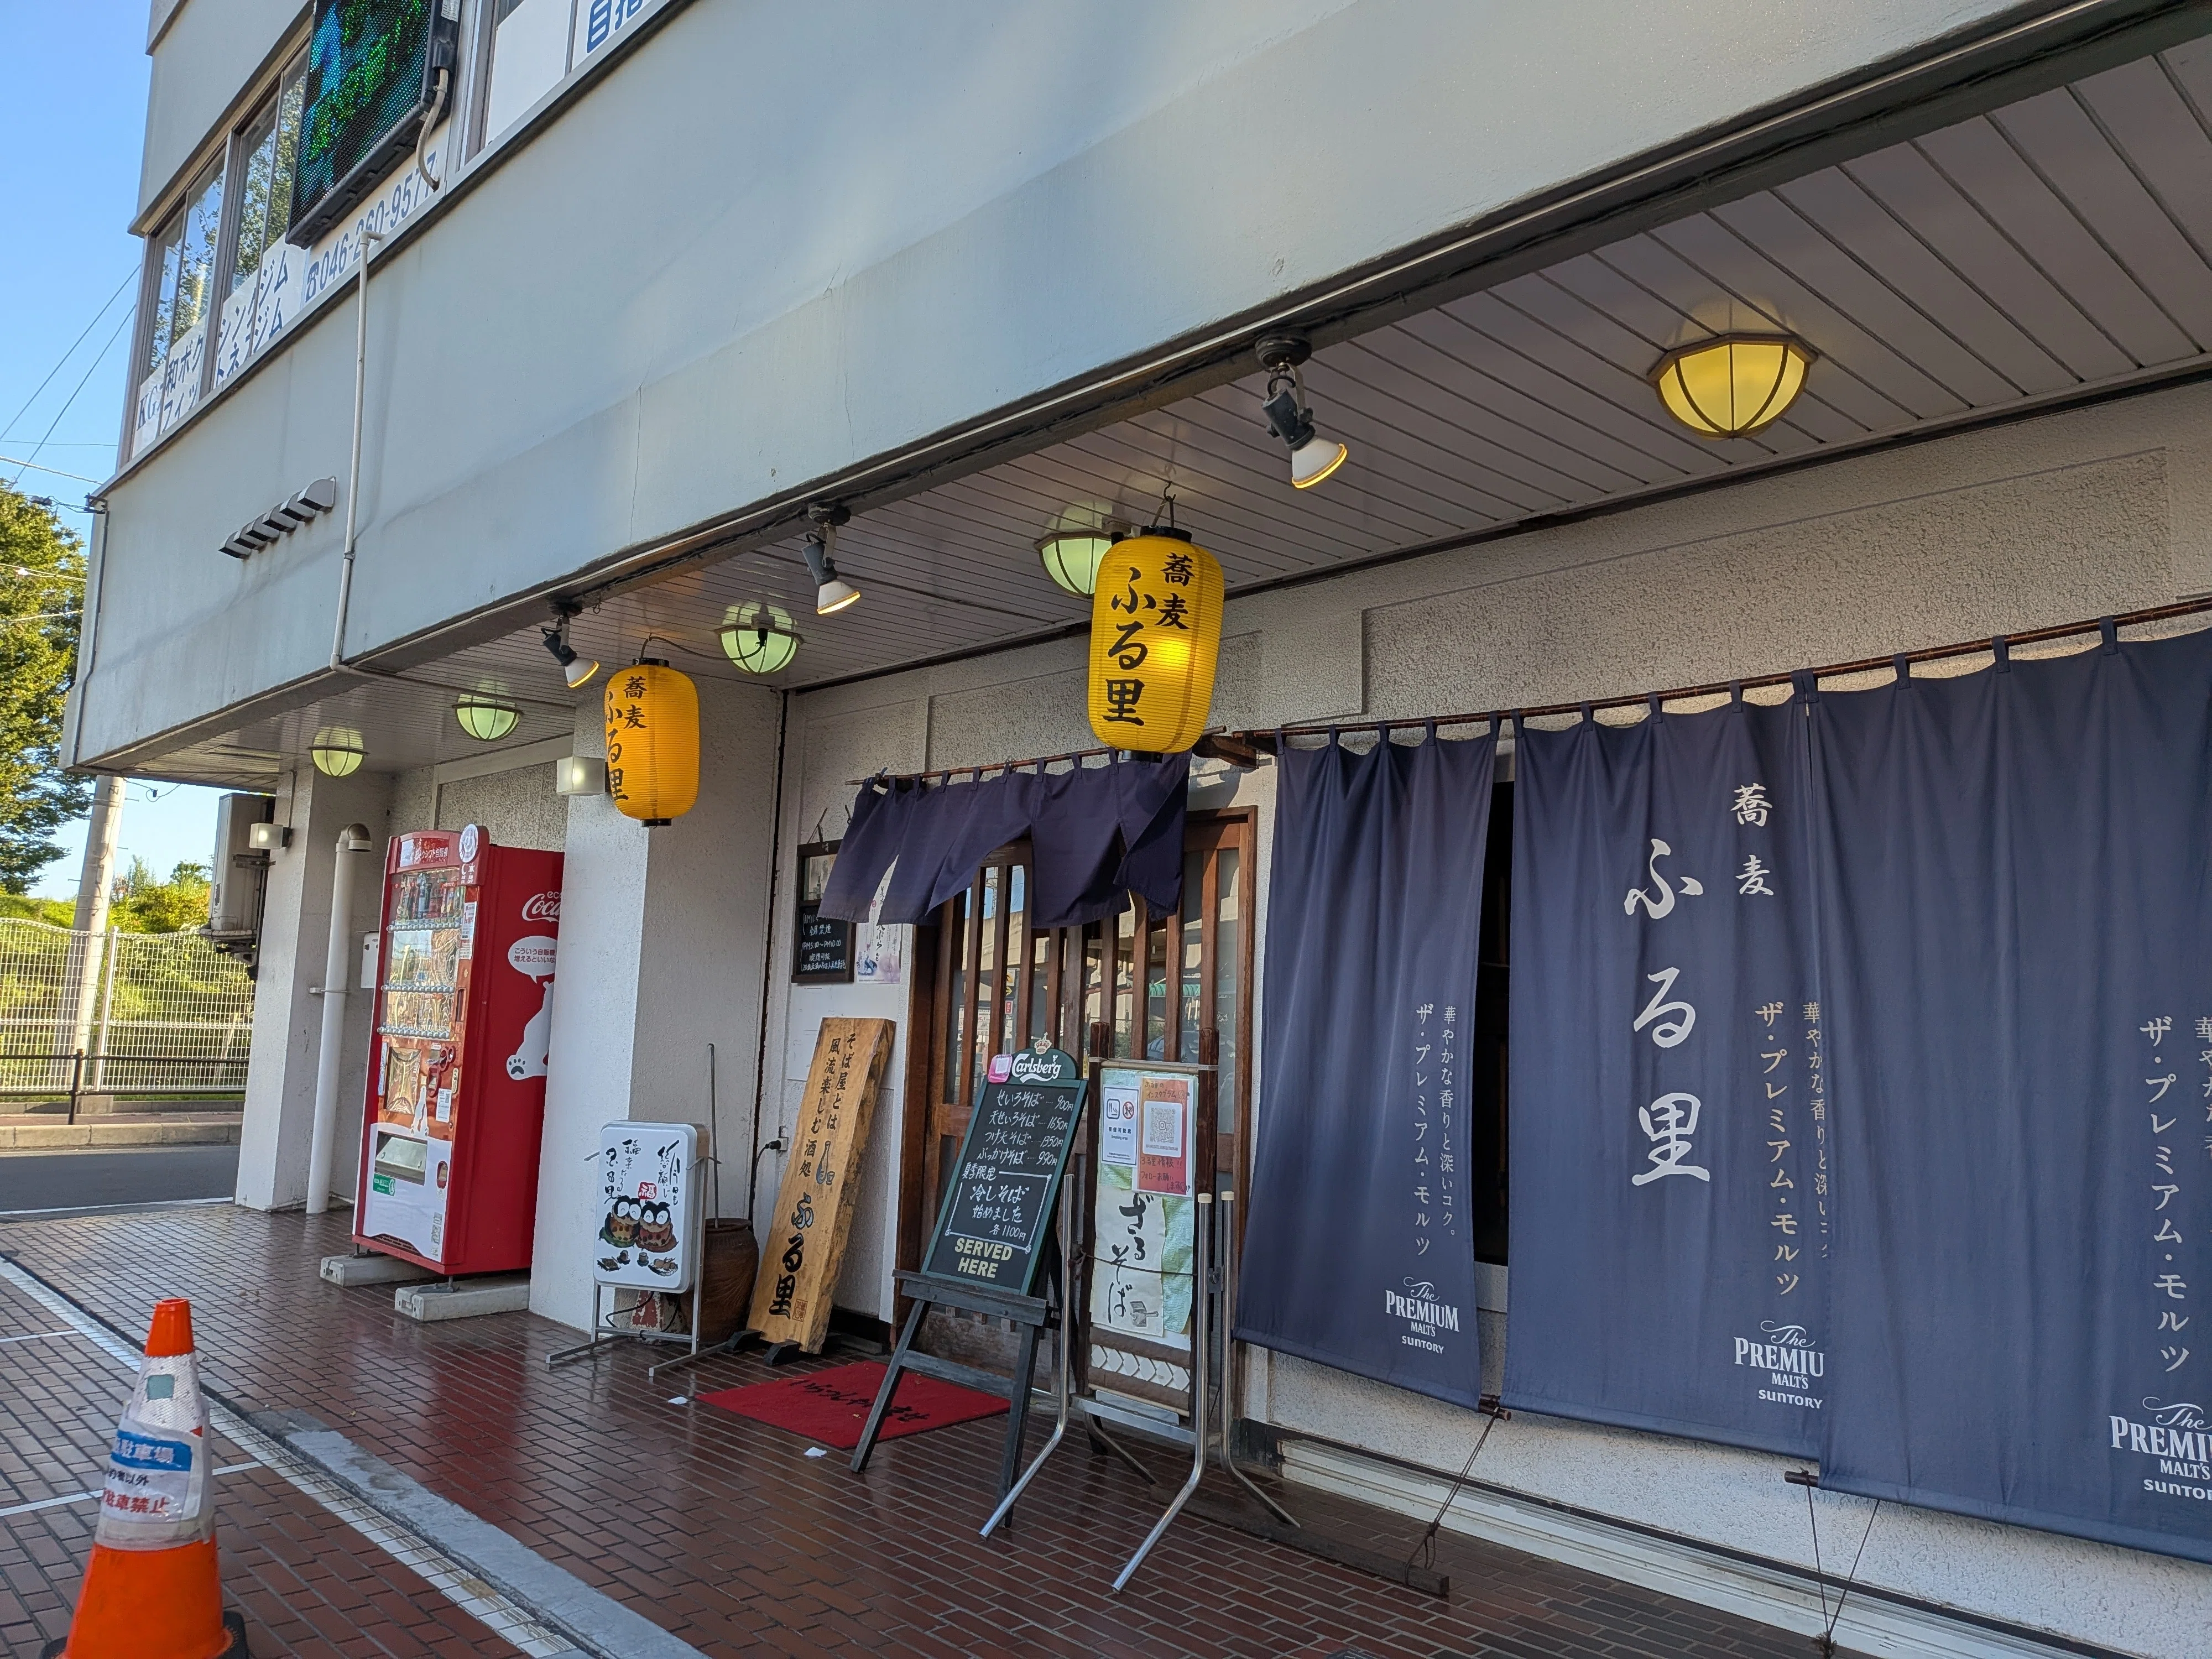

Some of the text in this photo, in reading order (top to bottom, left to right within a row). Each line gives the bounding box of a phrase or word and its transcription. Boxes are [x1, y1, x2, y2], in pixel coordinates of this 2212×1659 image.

[1154, 552, 1195, 630] 蕎麦
[1103, 567, 1157, 727] ふる里
[623, 676, 648, 729] 蕎麦
[605, 691, 629, 802] ふる里
[1730, 782, 1774, 896] 蕎麦
[514, 947, 557, 956] こういう自販機
[514, 955, 556, 963] 増えるといいな
[1624, 838, 1710, 1187] ふる里
[827, 1032, 856, 1130] そば屋とは
[1011, 1053, 1062, 1082] Carlsberg
[799, 1037, 841, 1177] 風流楽しむ酒処
[997, 1089, 1074, 1112] せいろそば 900円
[989, 1110, 1068, 1130] 天せいろそば 1650円
[1413, 1003, 1434, 1256] ザ・プレミアム・モルツ
[1439, 1005, 1455, 1236] 華やかな香りと深いコク。
[985, 1129, 1064, 1147] つけ天そば 1350円
[1755, 1001, 1799, 1296] ザ・プレミアム・モルツ
[977, 1147, 1058, 1166] ぶっかけそば 990円
[962, 1161, 997, 1181] 夏季限定
[970, 1183, 1030, 1204] 冷しそば
[2139, 1015, 2190, 1373] ザ・プレミアム・モルツ
[972, 1203, 1022, 1223] 始めました
[1119, 1192, 1154, 1261] ざる
[769, 1192, 814, 1320] ふる里
[954, 1238, 1013, 1261] SERVED
[958, 1257, 999, 1279] HERE
[1403, 1276, 1439, 1302] The
[1385, 1289, 1460, 1333] PREMIUM
[1410, 1320, 1436, 1338] MALT'S
[1760, 1319, 1816, 1348] The
[1401, 1334, 1445, 1355] SUNTORY
[1771, 1371, 1809, 1390] MALT'S
[1757, 1388, 1823, 1410] SUNTORY
[2142, 1396, 2212, 1431] The
[113, 1437, 174, 1465] 駐車場
[2160, 1459, 2211, 1480] MALT'S
